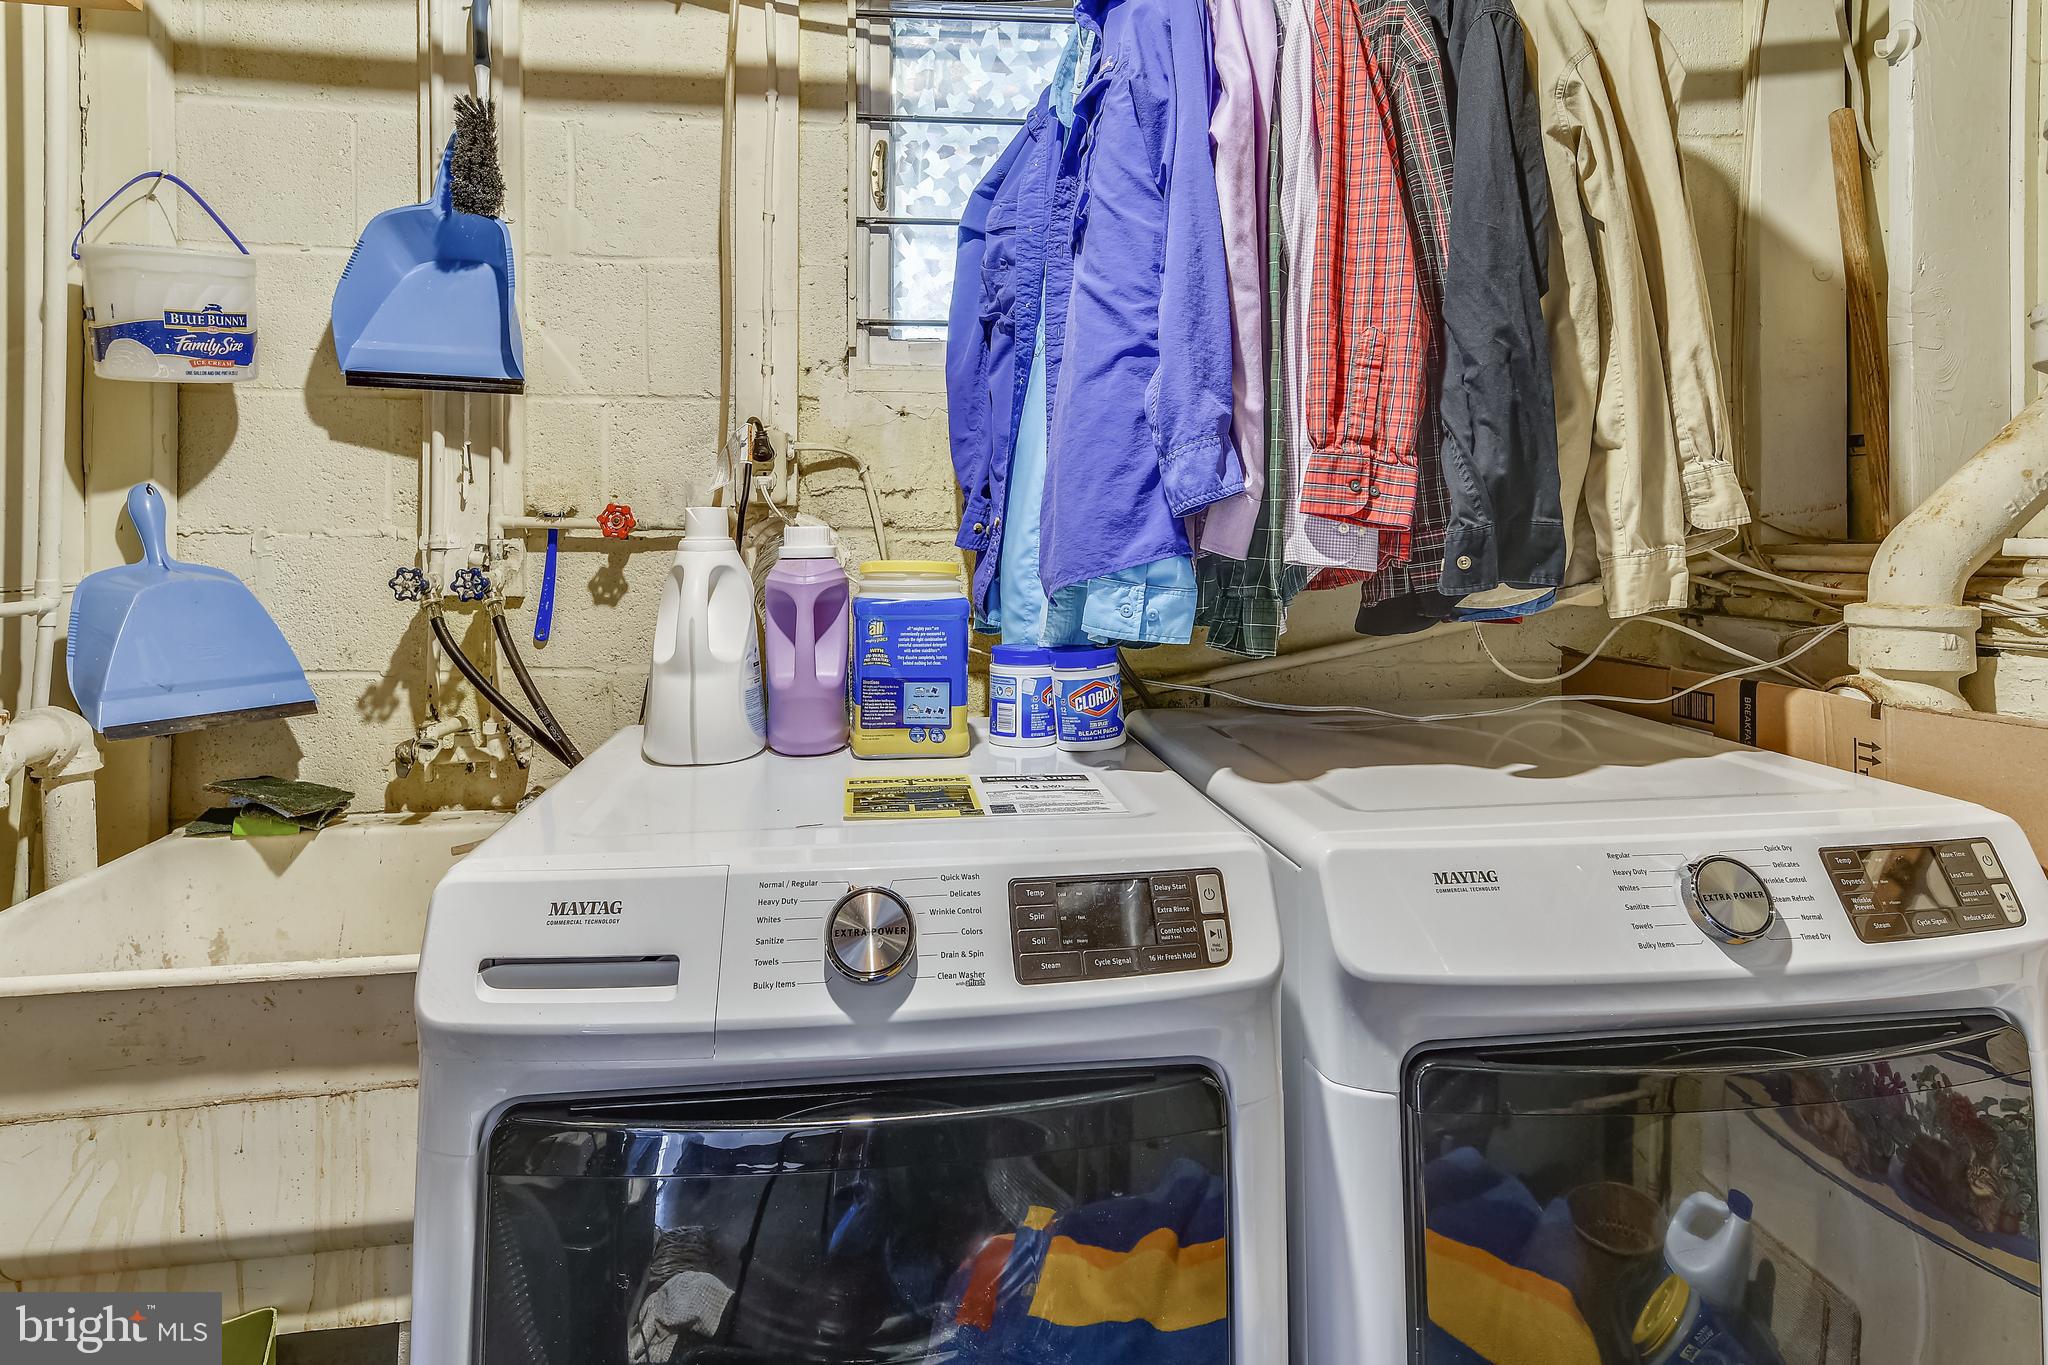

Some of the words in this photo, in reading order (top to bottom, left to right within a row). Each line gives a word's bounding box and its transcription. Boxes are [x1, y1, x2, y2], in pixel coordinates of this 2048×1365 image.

[170, 313, 205, 325] BLUE
[174, 334, 221, 356] Family
[219, 337, 244, 355] Size
[869, 621, 884, 636] all
[1074, 685, 1116, 712] CLOROX
[1078, 729, 1101, 737] BLEACH
[1102, 726, 1118, 735] PACKS
[1606, 852, 1630, 860] Regular
[1632, 868, 1647, 876] Duty
[940, 874, 960, 882] Quick
[1432, 870, 1499, 885] MAYTAG
[791, 880, 818, 888] Regular
[1840, 878, 1866, 886] Dryness
[1026, 889, 1045, 898] Temp
[1702, 893, 1731, 902] EXTRA
[1733, 891, 1765, 900] POWER
[758, 899, 780, 907] Heavy
[781, 897, 798, 906] Duty
[548, 900, 623, 916] MAYTAG
[957, 907, 982, 915] Control
[1624, 903, 1650, 911] Sanitize
[757, 916, 781, 924] Whites
[1029, 913, 1045, 921] Spin
[1631, 922, 1654, 930] Towels
[834, 929, 867, 938] EXTRA
[871, 927, 907, 935] POWER
[1160, 927, 1182, 935] Control
[755, 937, 785, 945] Sanitize
[1031, 937, 1046, 945] Soil
[1820, 933, 1831, 941] Dry
[1638, 942, 1656, 950] Bulky
[940, 951, 959, 959] Drain
[960, 950, 967, 958] &
[968, 949, 984, 959] Spin
[1165, 952, 1181, 960] Fresh
[754, 958, 779, 966] Towels
[1041, 962, 1061, 970] Steam
[1094, 959, 1111, 967] Cycle
[1112, 957, 1132, 966] Signal
[937, 972, 957, 980] Clean
[958, 971, 986, 979] Washer
[753, 981, 773, 990] Bulky
[775, 980, 796, 988] Items
